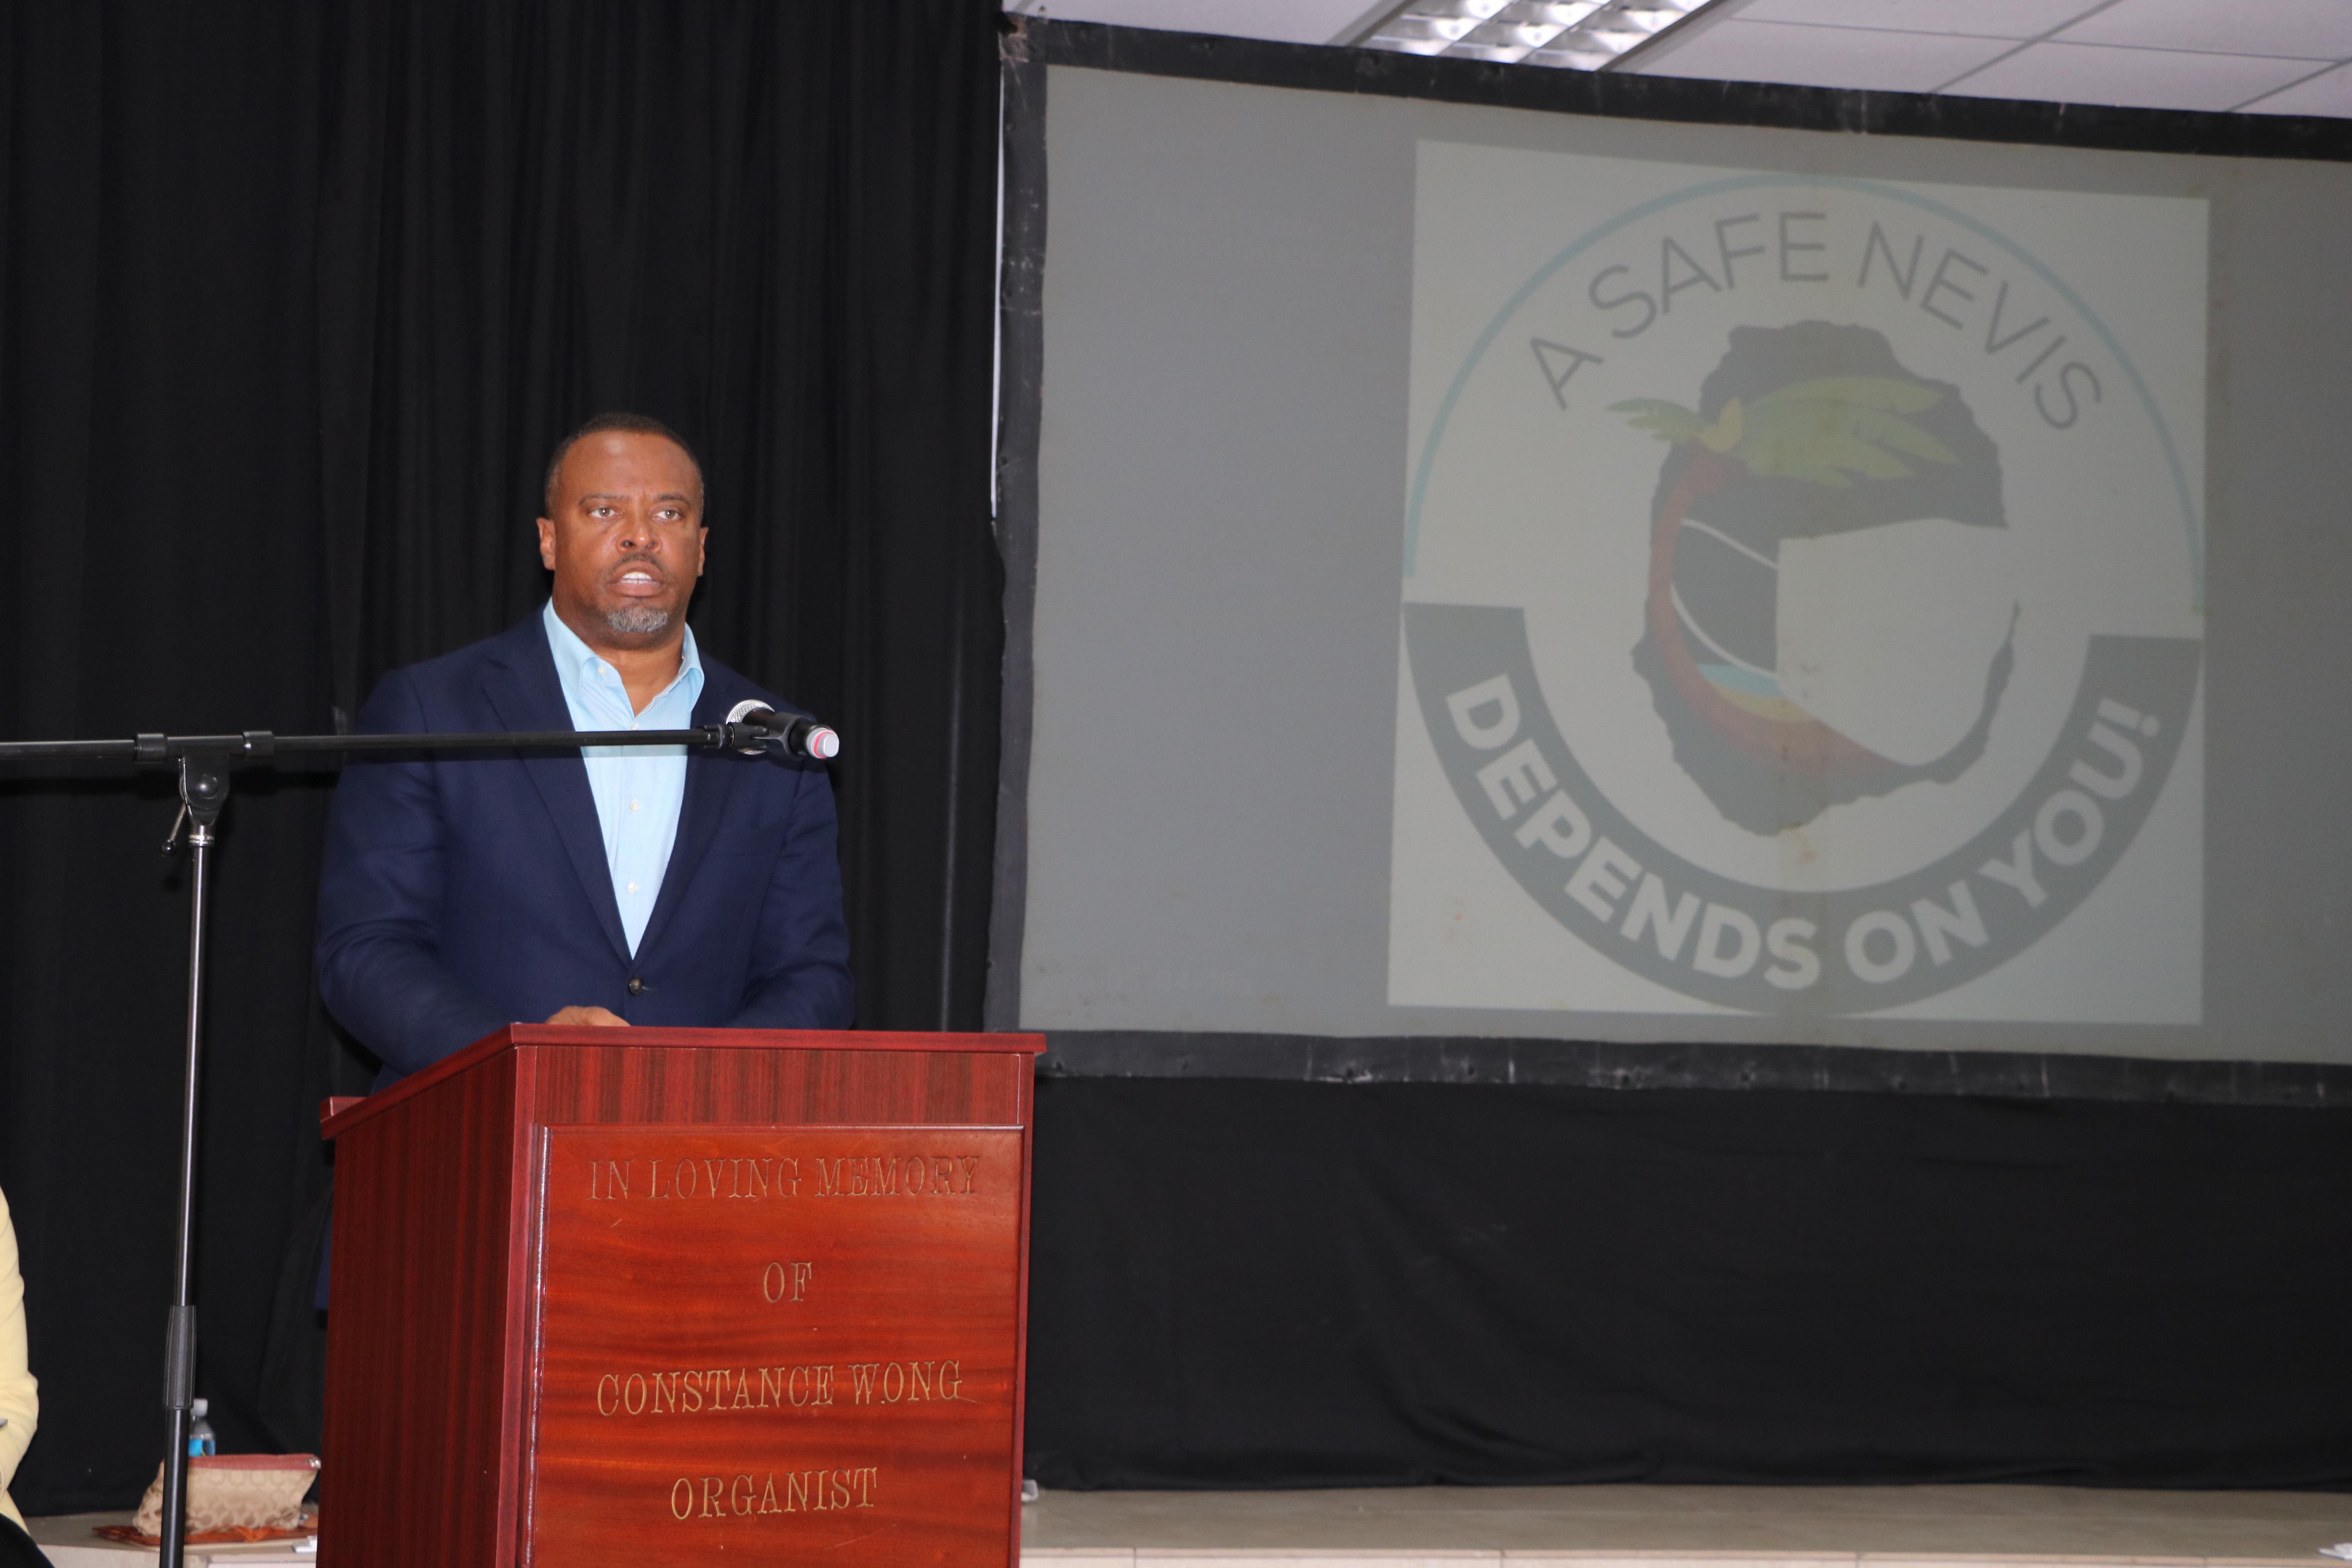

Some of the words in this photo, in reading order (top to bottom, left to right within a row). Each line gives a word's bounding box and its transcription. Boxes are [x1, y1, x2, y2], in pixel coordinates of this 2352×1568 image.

[1530, 335, 1603, 409] A
[1588, 212, 1828, 338] SAFE
[1858, 221, 2102, 430] NEVIS
[1446, 673, 1821, 989] DEPENDS
[1845, 882, 1989, 983] ON
[1981, 699, 2161, 910] YOU!
[590, 1161, 630, 1199] IN
[648, 1159, 801, 1198] LOVING
[815, 1157, 979, 1195] MEMORY
[763, 1261, 812, 1303] OF
[597, 1365, 834, 1416] CONSTANCE
[848, 1360, 962, 1404] WONG
[671, 1467, 877, 1519] ORGANIST
